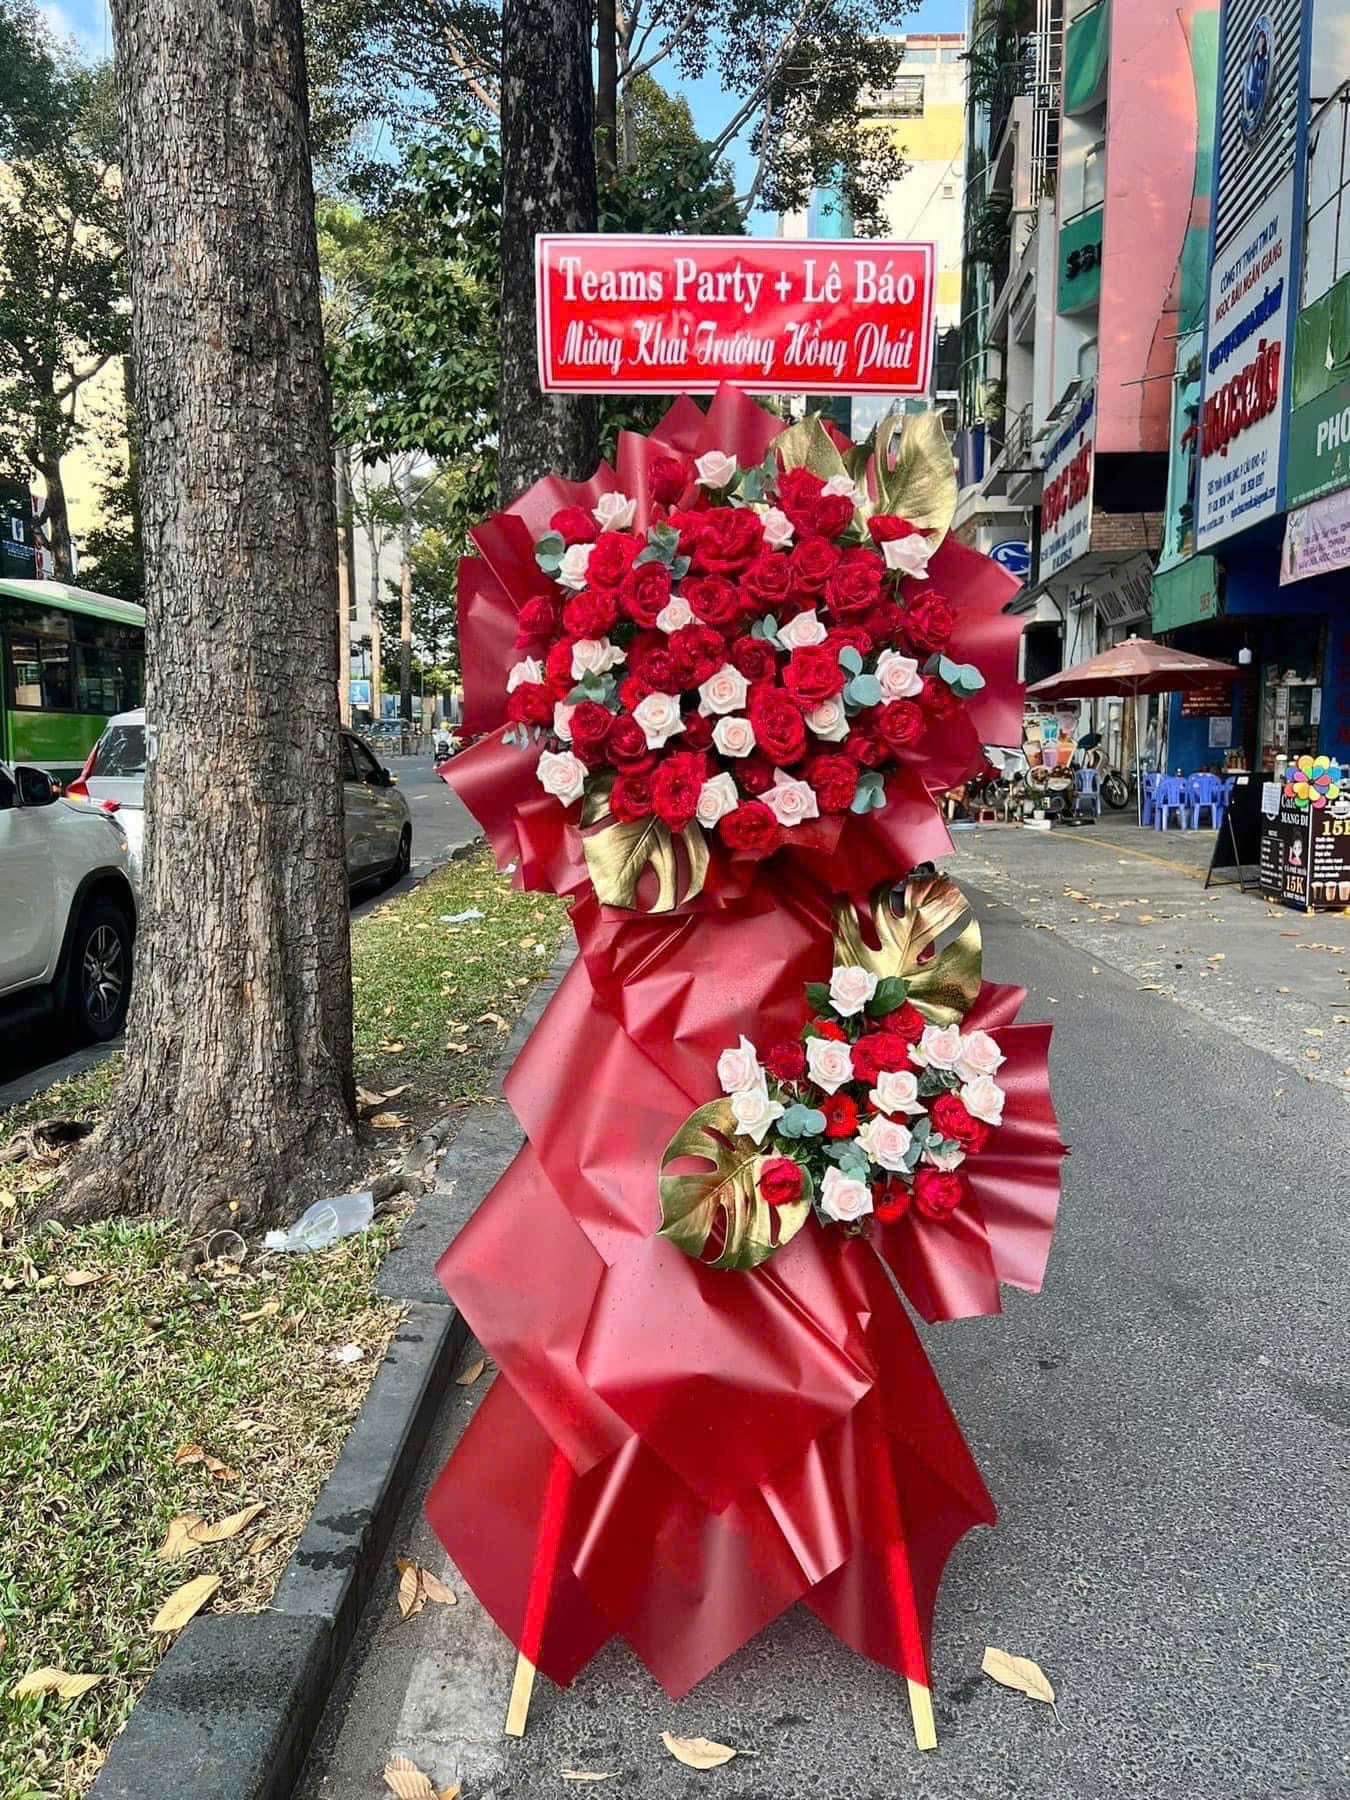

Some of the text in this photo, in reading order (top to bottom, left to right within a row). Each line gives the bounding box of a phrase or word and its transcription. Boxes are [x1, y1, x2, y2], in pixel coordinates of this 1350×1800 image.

[559, 256, 916, 314] Teams Party + Lê Báo
[559, 319, 915, 377] Mừng Khai Trương Hồng Phát
[1281, 811, 1300, 825] MANG
[1286, 874, 1305, 895] 15K
